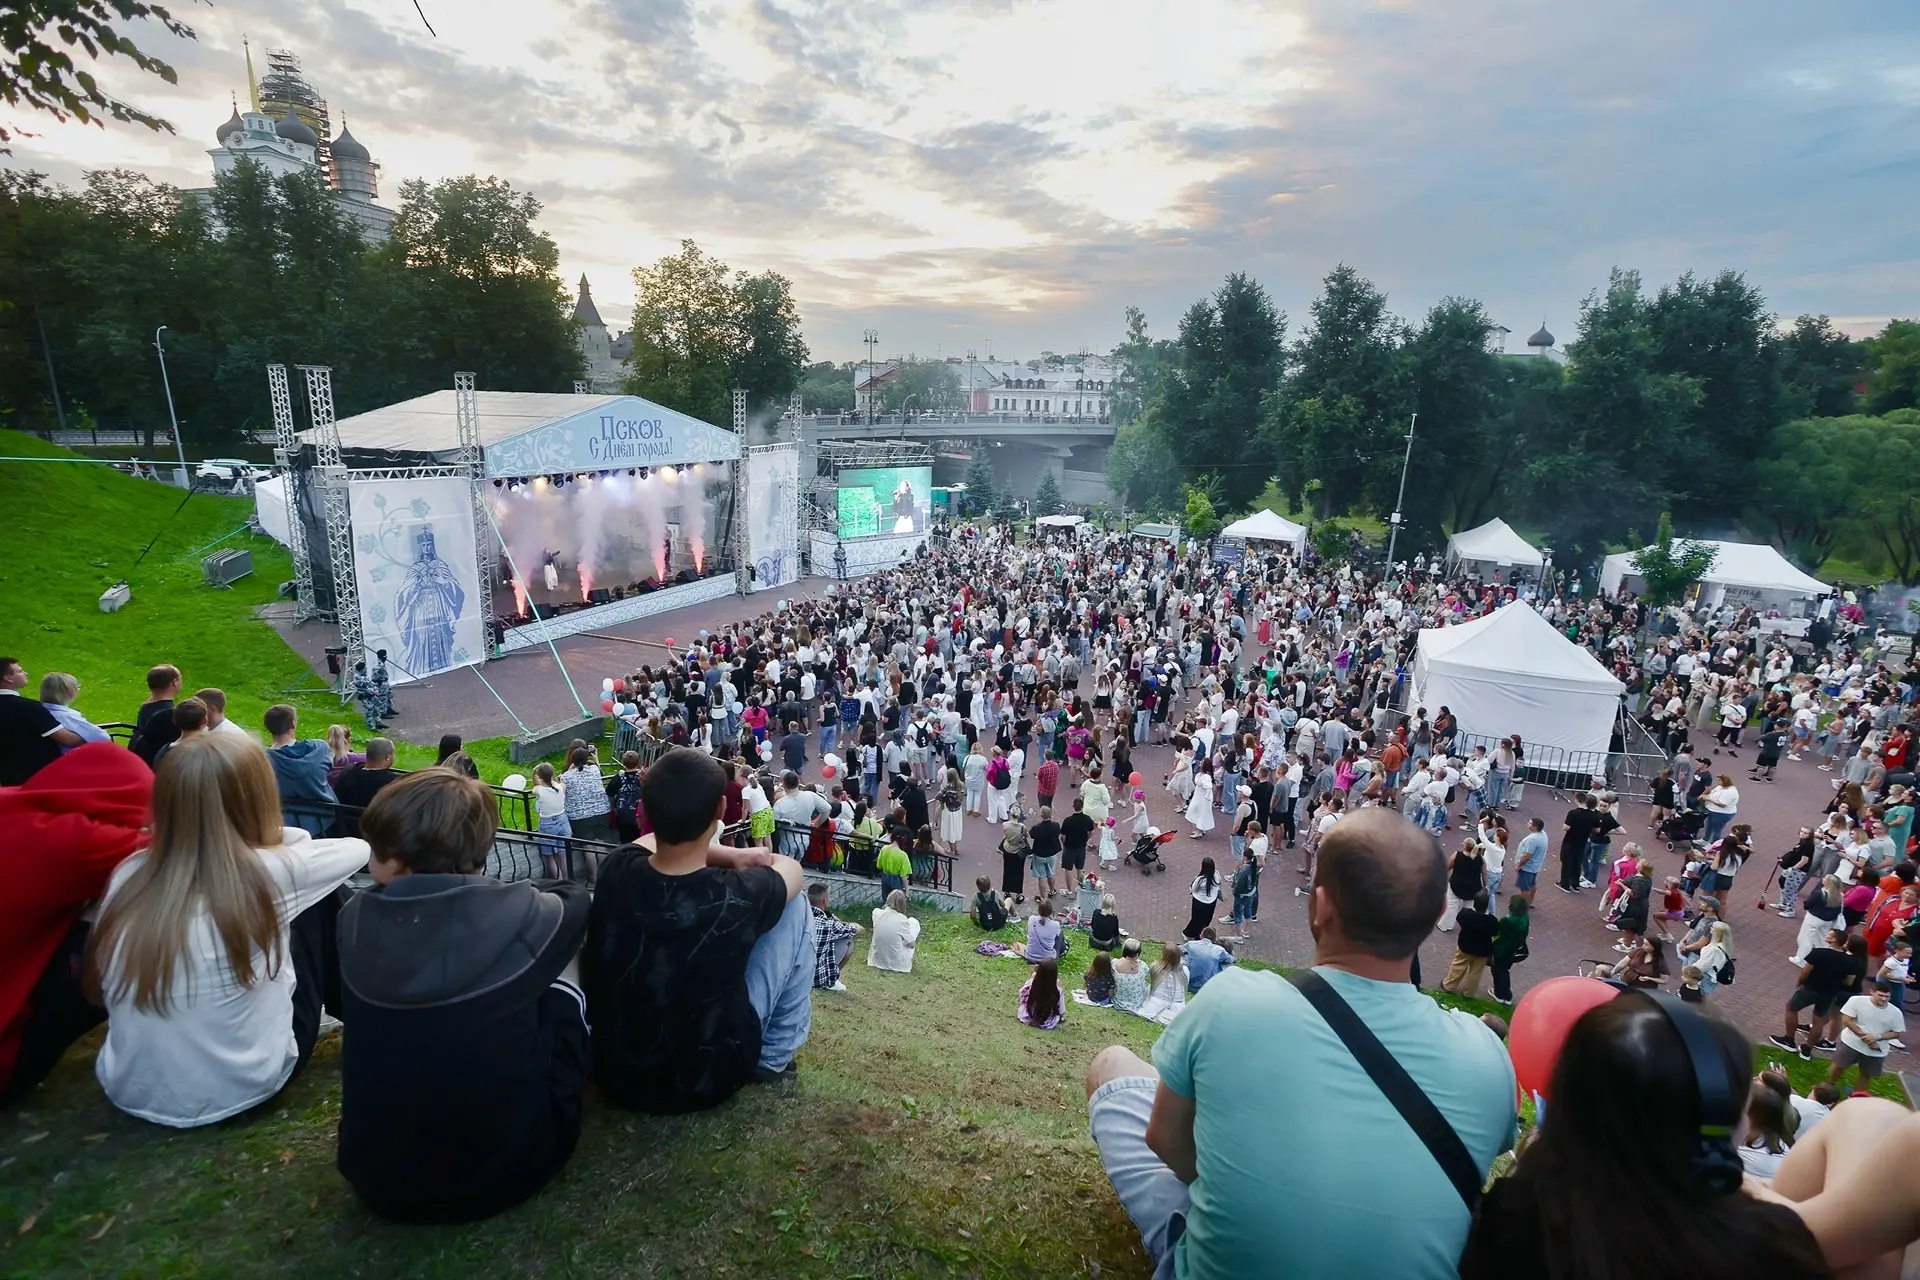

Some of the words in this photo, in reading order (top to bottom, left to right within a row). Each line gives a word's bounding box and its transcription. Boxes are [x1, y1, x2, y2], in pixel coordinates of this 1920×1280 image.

[600, 416, 664, 440] Псков
[603, 437, 635, 462] Днём
[638, 437, 673, 461] города!
